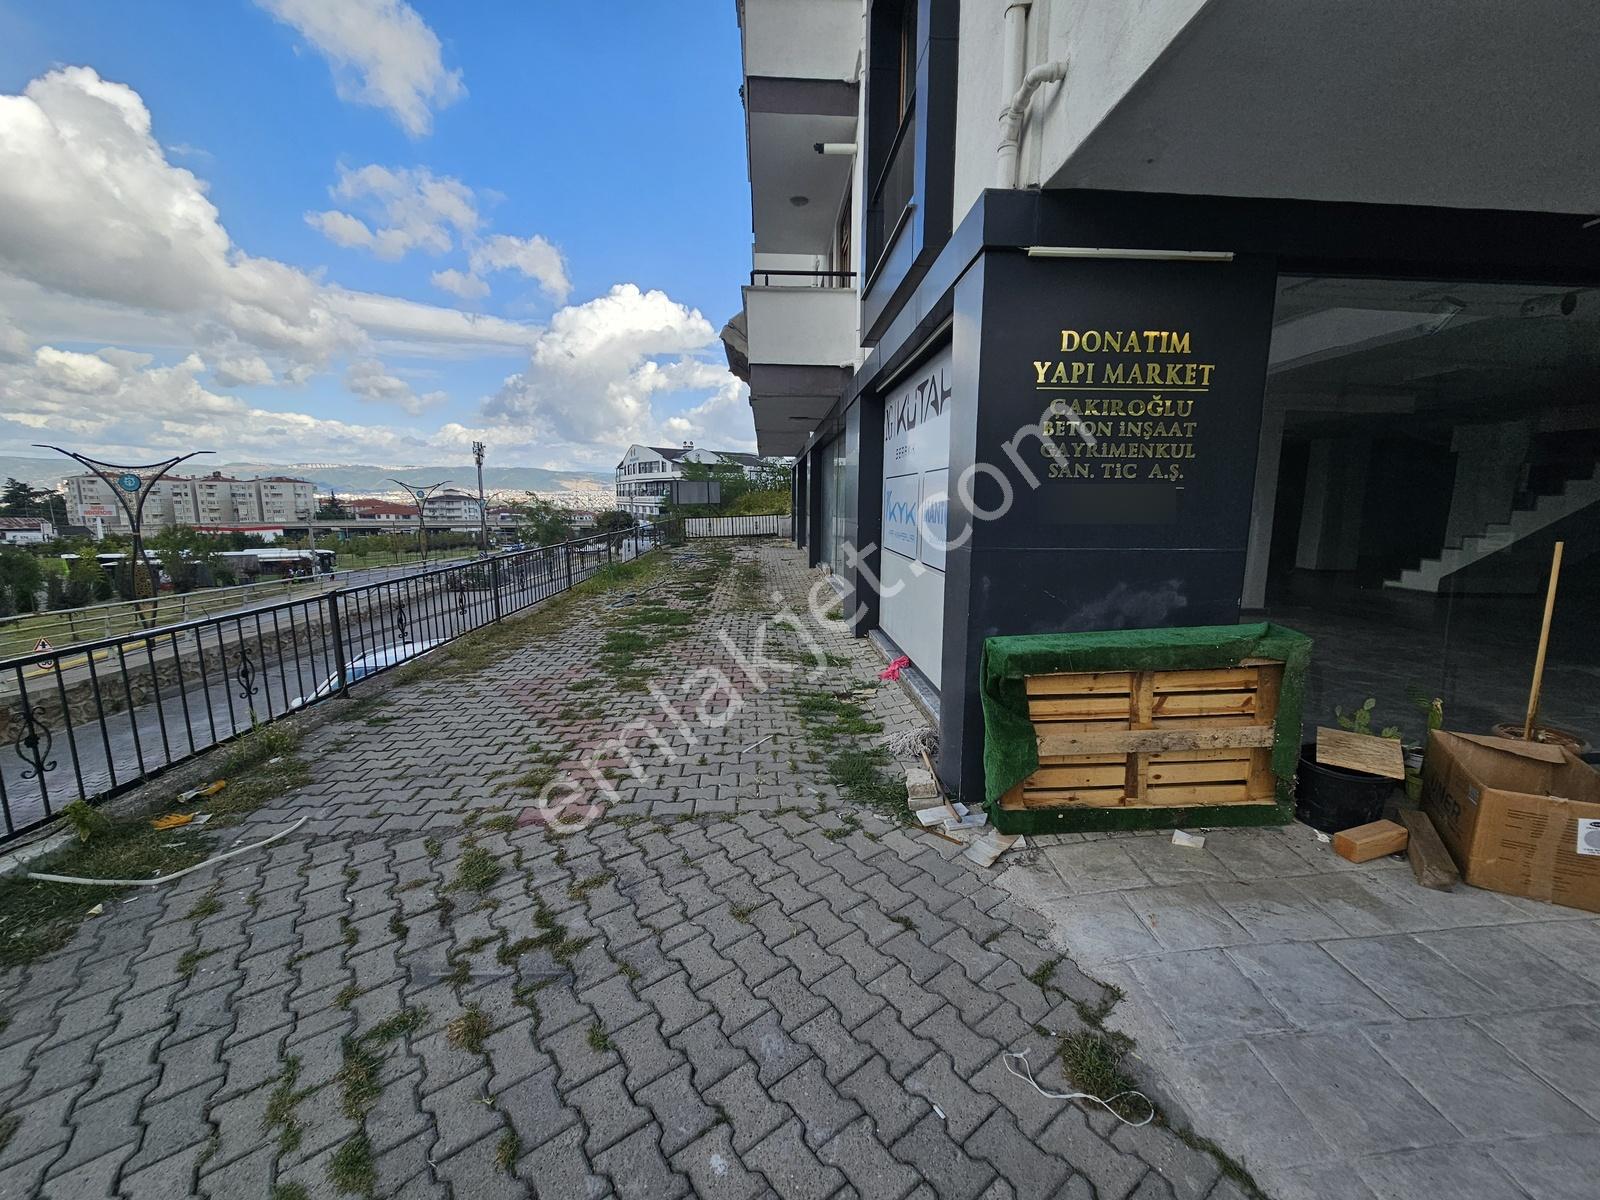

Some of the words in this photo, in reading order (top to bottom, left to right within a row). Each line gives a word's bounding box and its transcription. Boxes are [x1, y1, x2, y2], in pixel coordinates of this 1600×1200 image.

[1060, 330, 1192, 354] DONATIM
[1033, 361, 1095, 384] YAPI
[1102, 363, 1215, 386] MARKET
[1049, 394, 1194, 420] ÇAKIROĞLU
[1042, 420, 1113, 437] BETON
[1048, 463, 1095, 479] SAN.
[1148, 463, 1184, 481] A.Ş.
